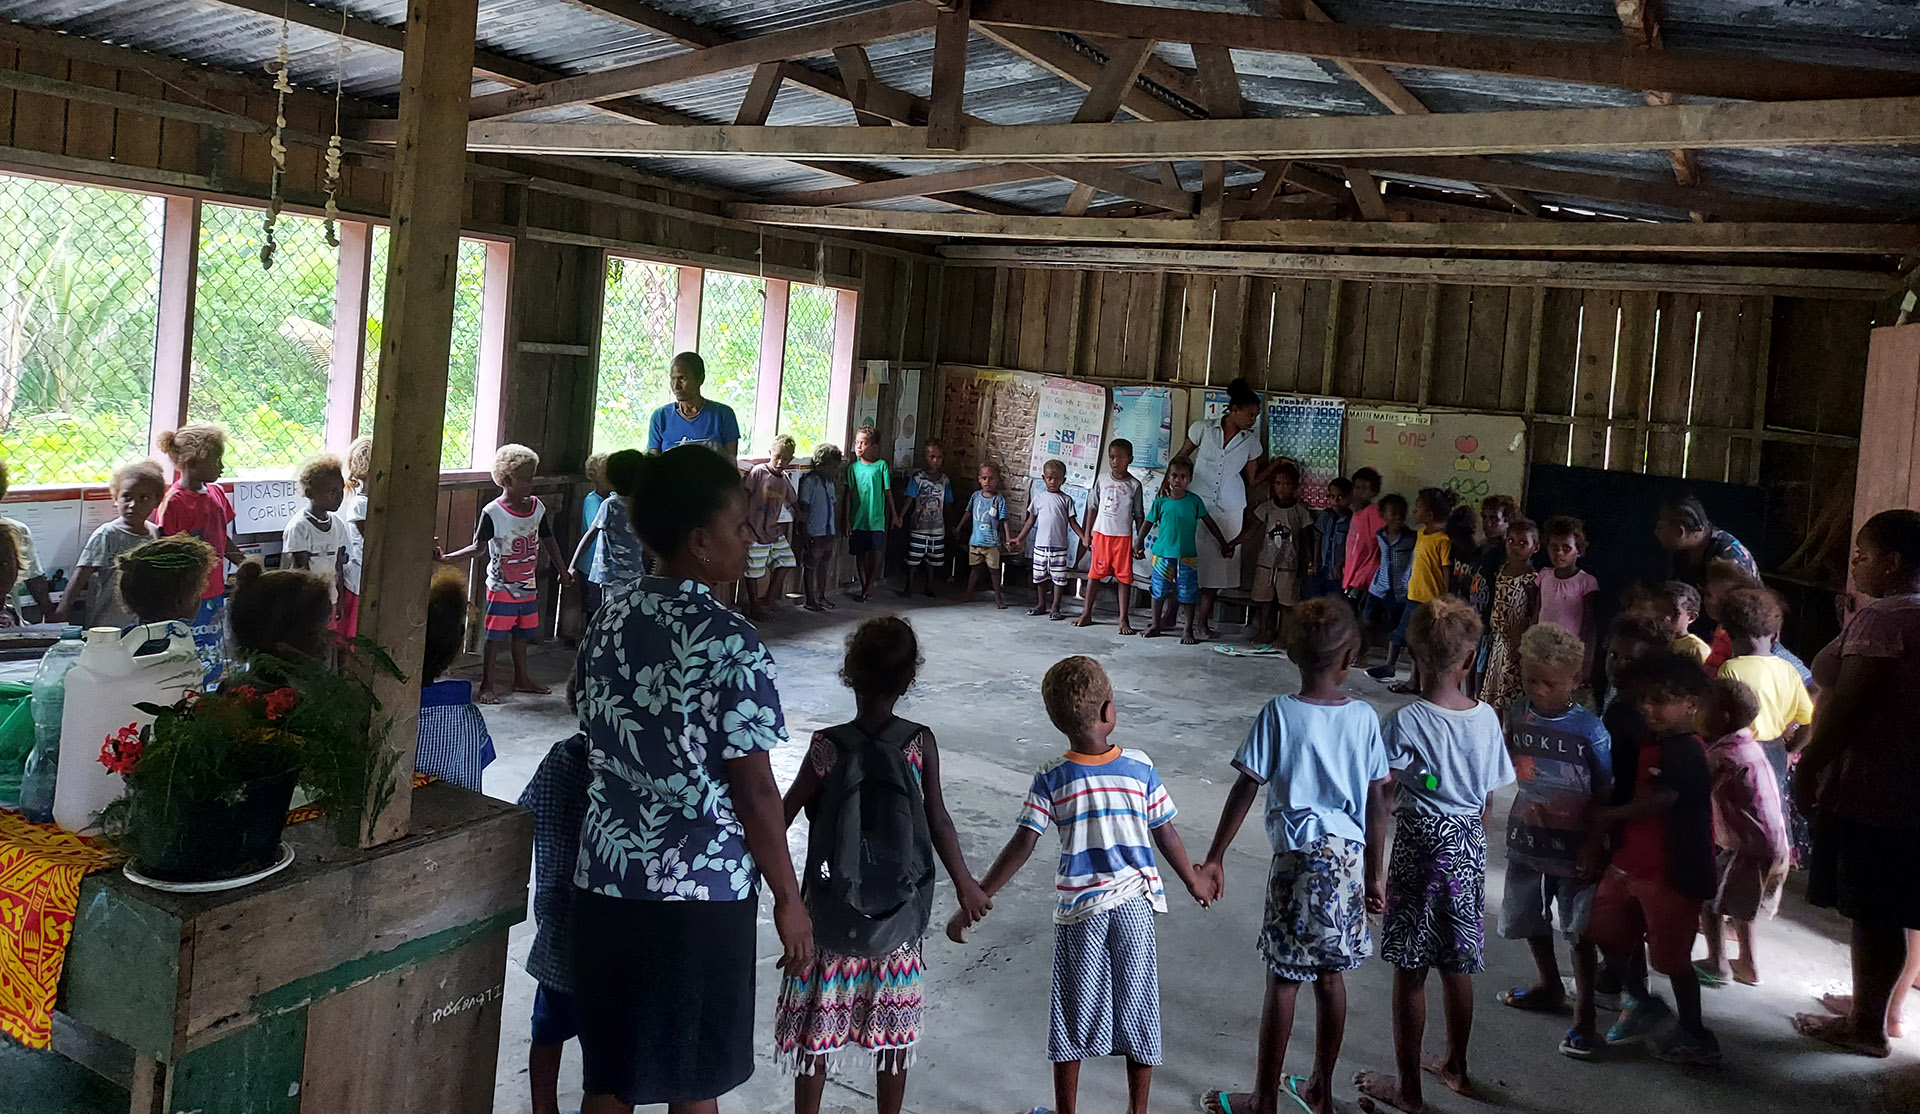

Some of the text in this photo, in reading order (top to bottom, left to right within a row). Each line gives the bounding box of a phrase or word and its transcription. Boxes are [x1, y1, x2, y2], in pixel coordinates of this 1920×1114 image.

[1209, 403, 1216, 414] 1
[1364, 425, 1427, 448] 1 one
[248, 501, 296, 521] CORNER
